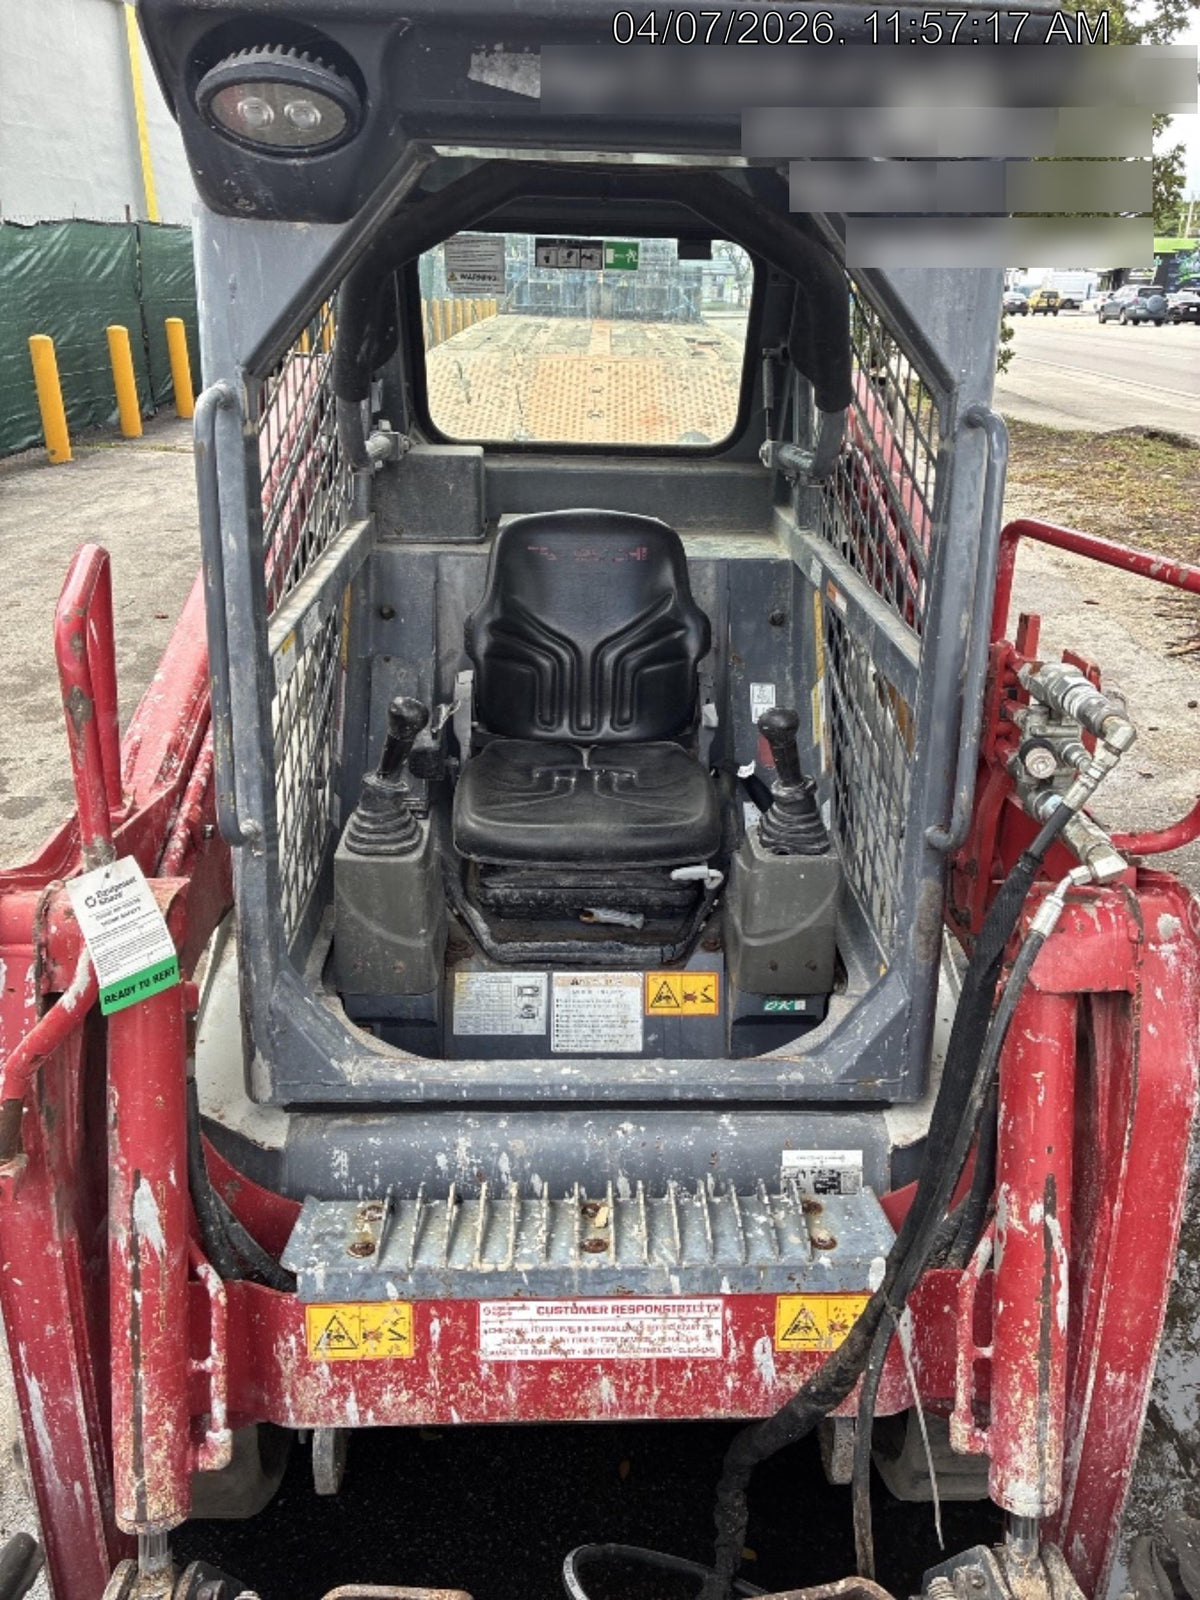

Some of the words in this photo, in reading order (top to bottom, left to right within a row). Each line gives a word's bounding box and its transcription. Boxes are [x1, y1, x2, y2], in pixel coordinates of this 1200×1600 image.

[104, 984, 136, 1005] READY
[138, 977, 151, 991] TO
[152, 965, 176, 984] RENT
[536, 1304, 609, 1315] CUSTOMER
[611, 1303, 720, 1315] RESPONSIBILITY
